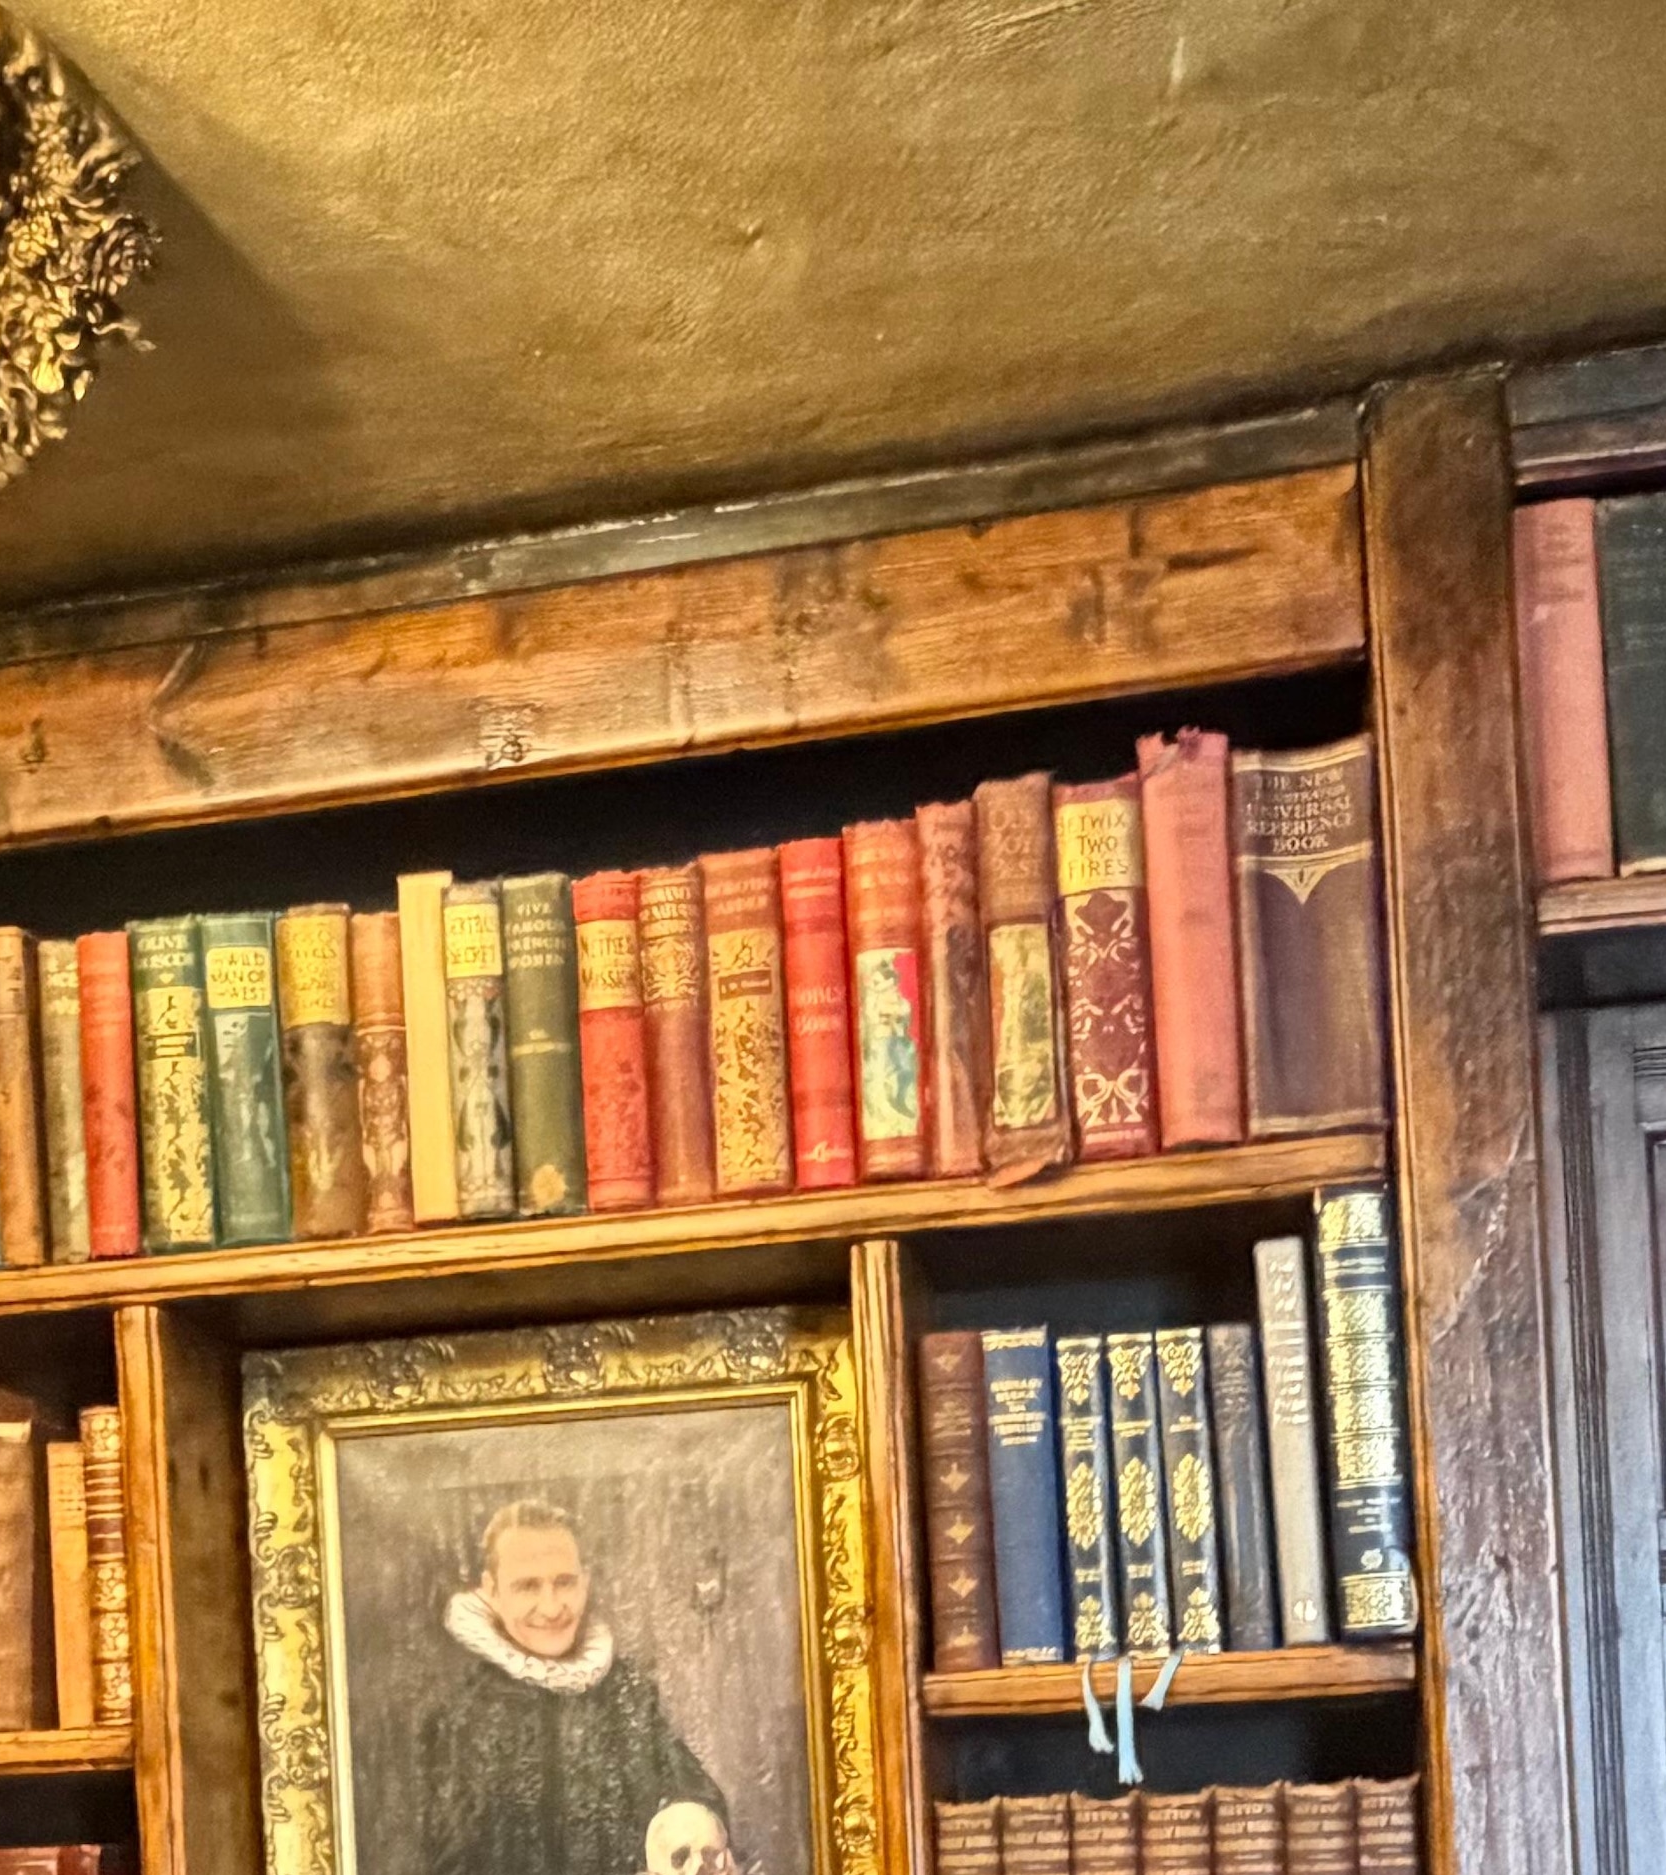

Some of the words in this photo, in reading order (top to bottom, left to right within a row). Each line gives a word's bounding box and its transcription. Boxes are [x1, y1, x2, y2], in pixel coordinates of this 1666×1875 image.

[1245, 795, 1351, 819] UNIVERSAL
[1057, 812, 1129, 836] BETWIX
[1245, 812, 1352, 836] REFERENCE
[1076, 835, 1119, 856] TWO
[1273, 833, 1330, 853] BOOK
[1068, 859, 1132, 880] FIRES
[517, 903, 552, 916] FIVE
